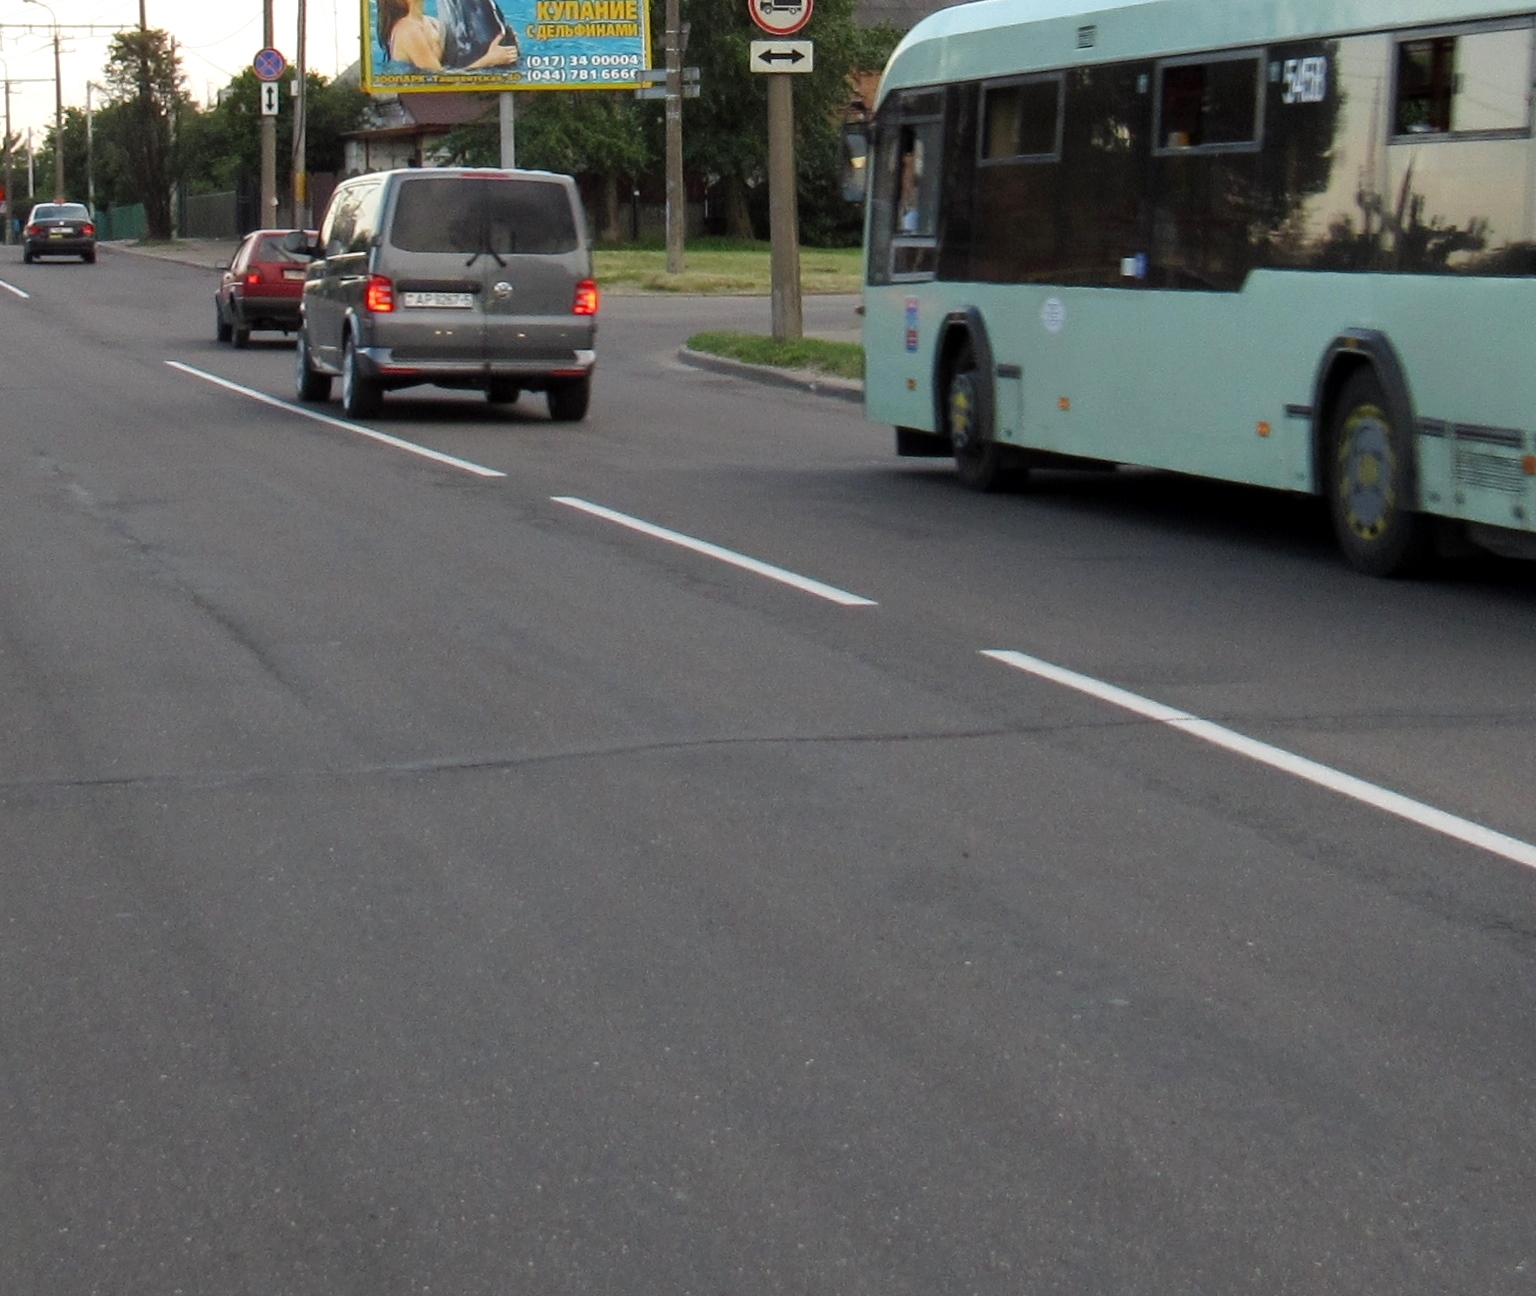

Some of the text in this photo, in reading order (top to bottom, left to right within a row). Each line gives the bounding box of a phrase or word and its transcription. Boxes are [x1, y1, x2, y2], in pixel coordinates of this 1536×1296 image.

[536, 0, 638, 21] КУПАНИЕ
[536, 23, 638, 40] ДЕЛЬФИНАМИ
[526, 54, 638, 68] (017) 34 00004
[527, 69, 566, 82] (044)
[570, 69, 597, 80] 781
[1282, 56, 1327, 104] 5458
